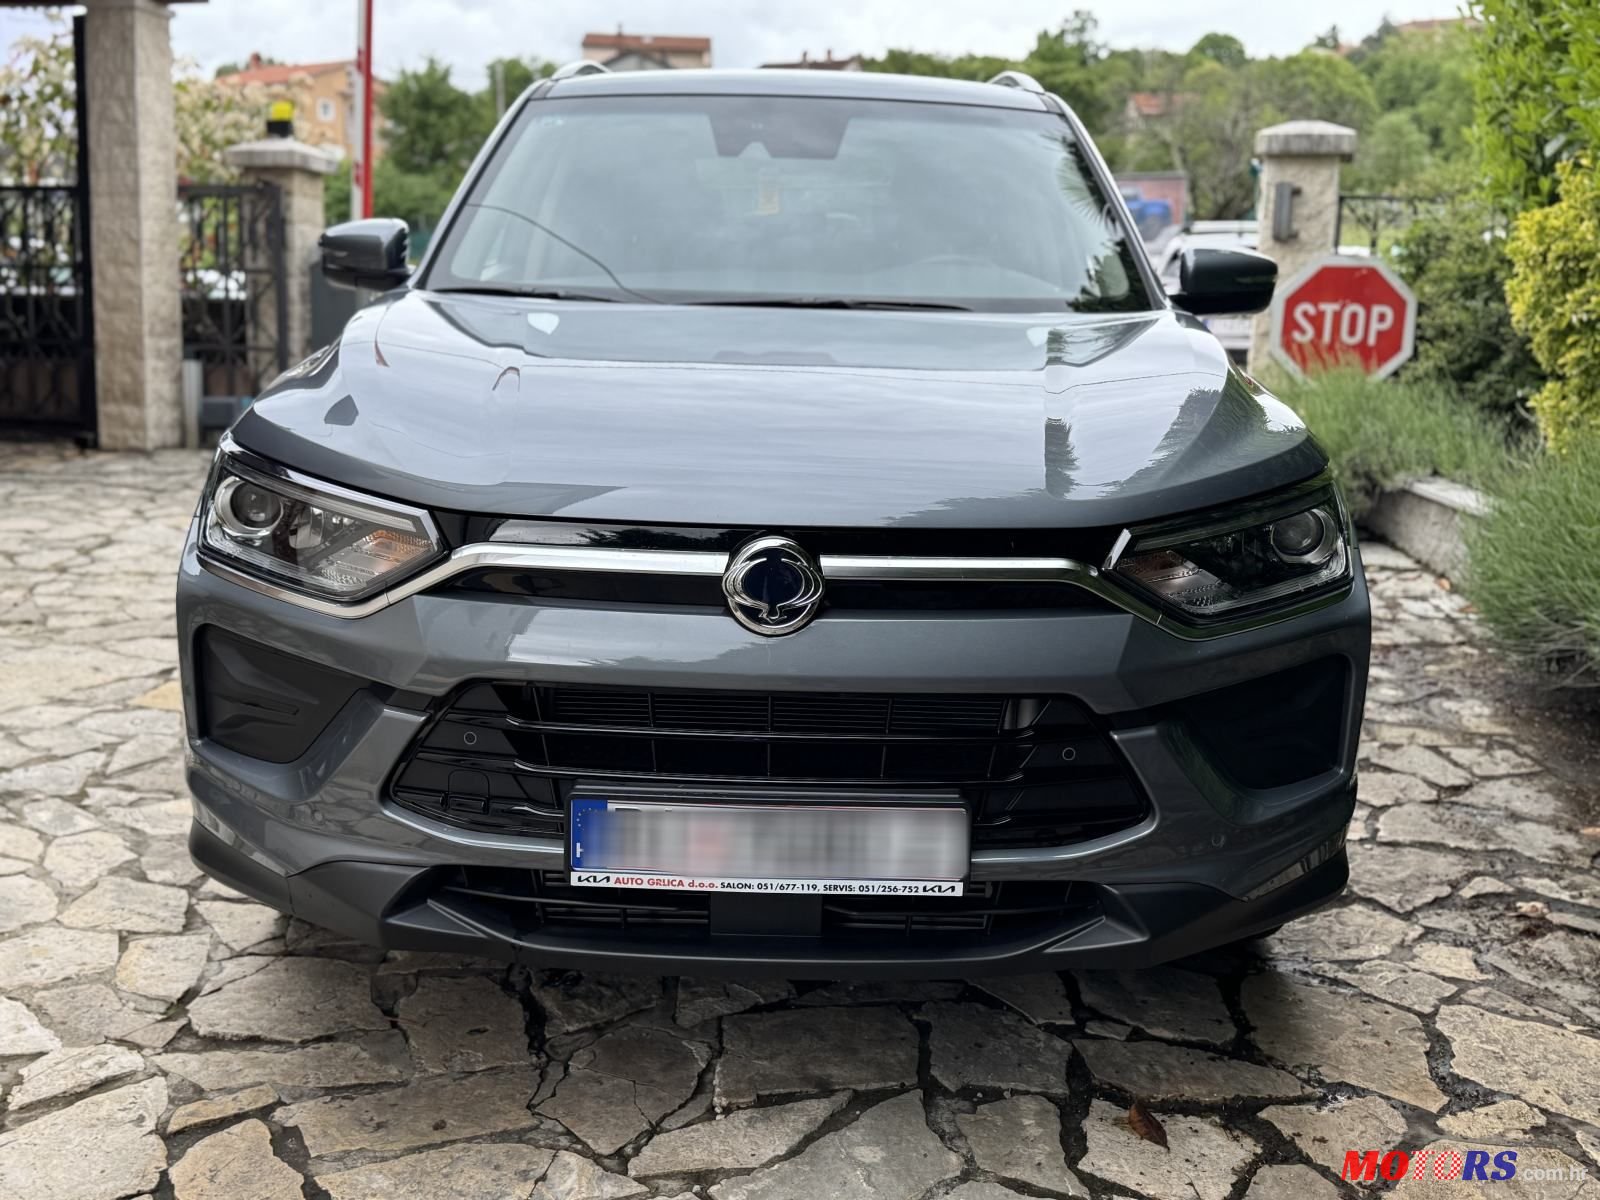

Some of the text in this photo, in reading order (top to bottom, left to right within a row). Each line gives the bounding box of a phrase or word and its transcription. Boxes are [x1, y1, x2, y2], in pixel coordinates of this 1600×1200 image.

[1291, 302, 1395, 346] STOP
[614, 877, 644, 886] AUTO
[688, 880, 719, 889] d.o.o.
[720, 881, 755, 890] SALON:
[757, 882, 820, 892] 051/677-119,
[823, 884, 856, 892] SERVIS:
[858, 884, 919, 893] 051/256-752
